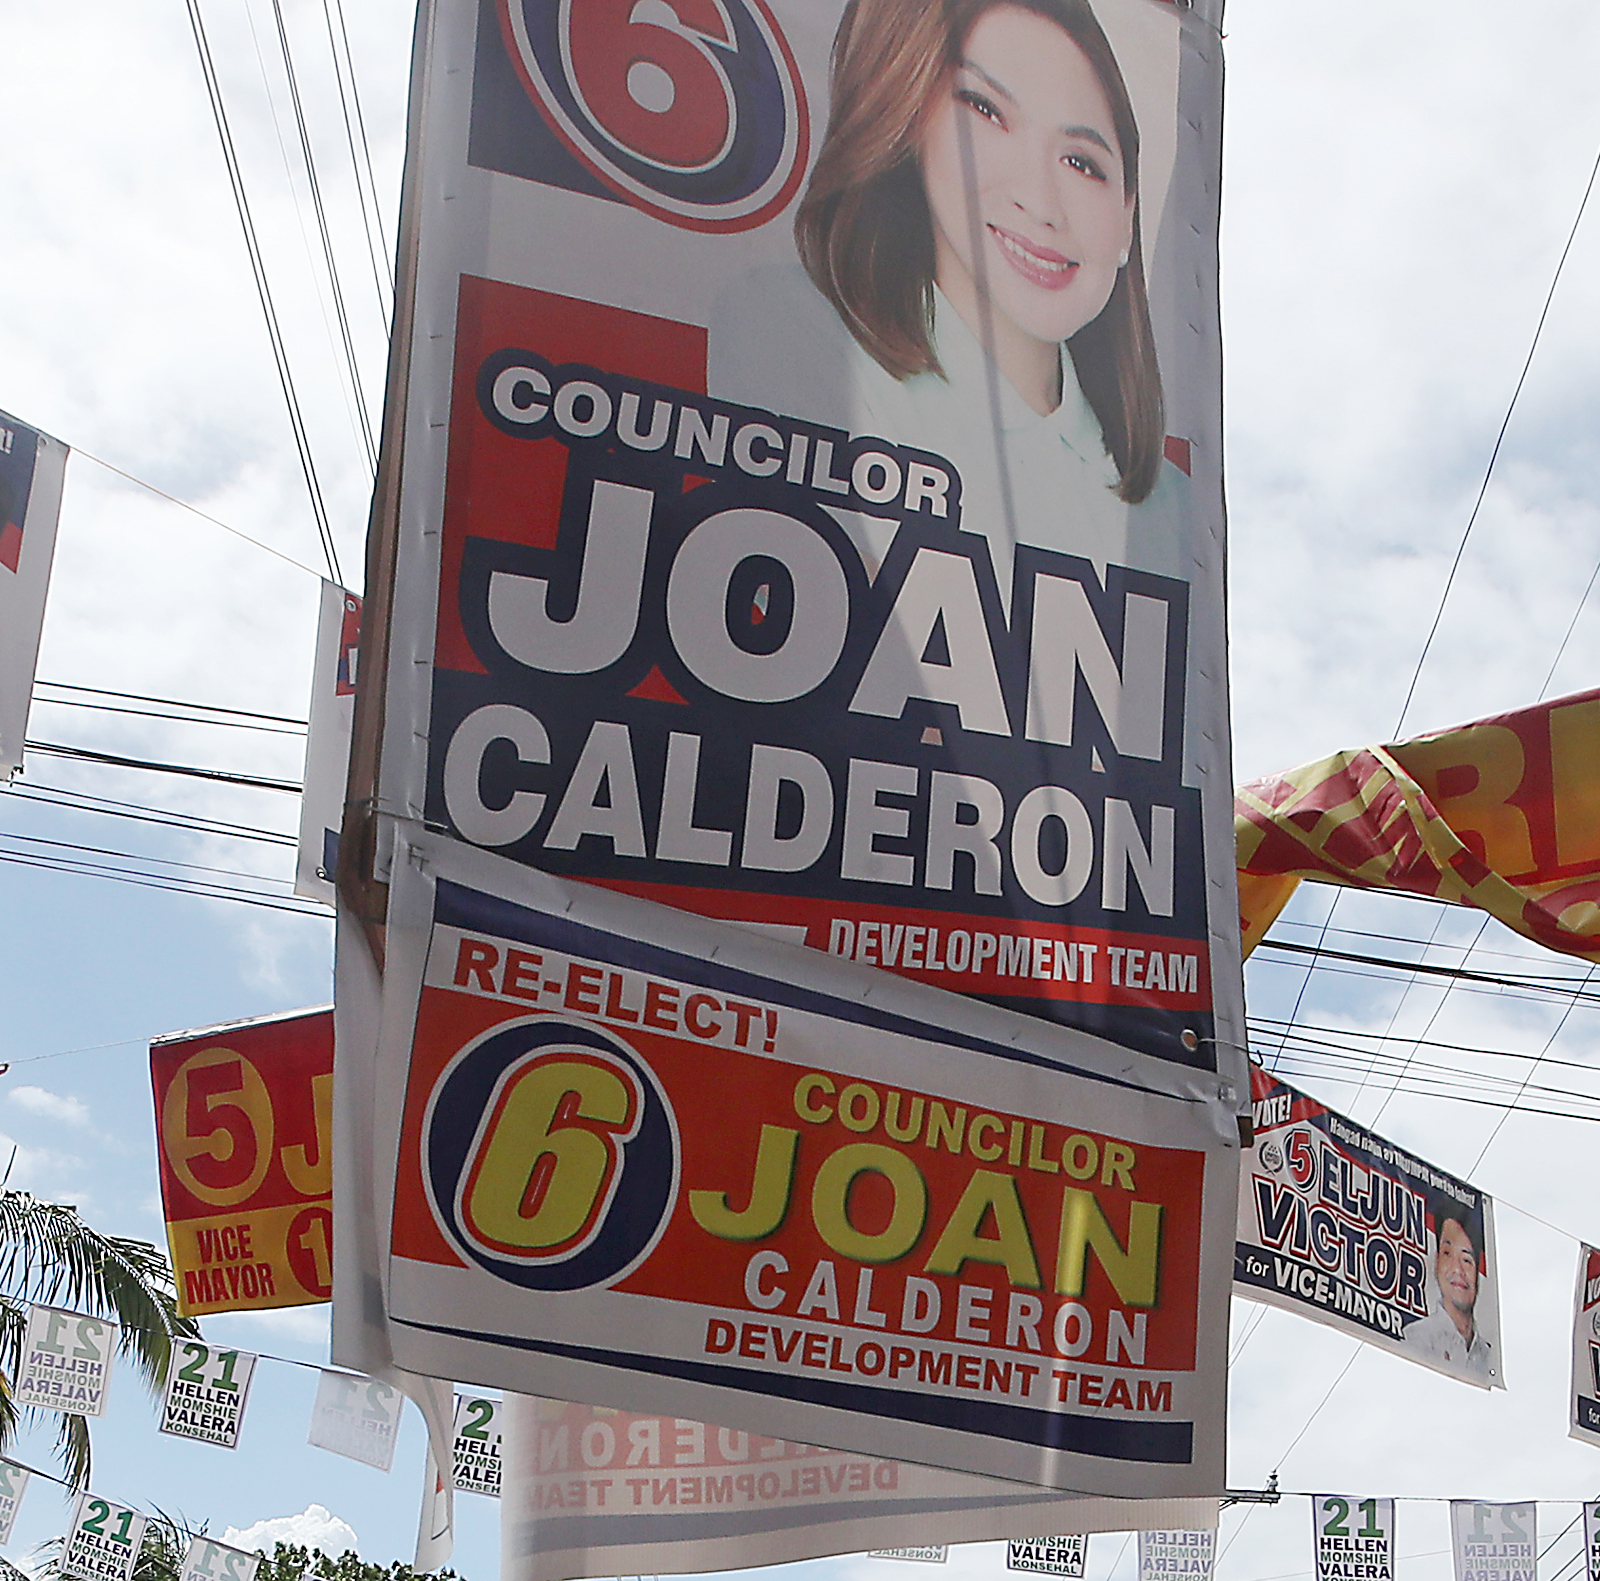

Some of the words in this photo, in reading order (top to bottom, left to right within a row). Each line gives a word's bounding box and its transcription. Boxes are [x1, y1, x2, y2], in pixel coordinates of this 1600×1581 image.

[558, 0, 740, 173] 6
[490, 364, 953, 519] COUNCILOR
[486, 478, 1170, 767] JOAN
[442, 702, 1177, 918] CALDERON
[451, 935, 780, 1054] RE-ELECT!
[828, 917, 1096, 982] DEVELOPMENT
[1108, 943, 1199, 995] TEAM
[185, 1059, 258, 1190] 5
[1251, 1094, 1292, 1130] VOTE!
[466, 1058, 633, 1261] 6
[792, 1072, 1138, 1193] COUNCILOR
[195, 1223, 253, 1263] VICE
[687, 1122, 1167, 1308] JOAN
[1251, 1173, 1427, 1316] VICTOR
[744, 1250, 1150, 1366] CALDERON
[169, 1394, 237, 1420] MOMSHIE
[171, 1379, 240, 1407] HELLEN
[703, 1319, 1037, 1403] DEVELOPMENT
[1051, 1369, 1174, 1414] TEAM
[164, 1421, 233, 1445] KONSEHAL
[166, 1406, 237, 1435] VALERA
[1320, 1537, 1388, 1554] HELLEN
[1320, 1551, 1388, 1565] MOMSHIE
[1323, 1498, 1385, 1539] 21
[1318, 1562, 1392, 1581] VALERA
